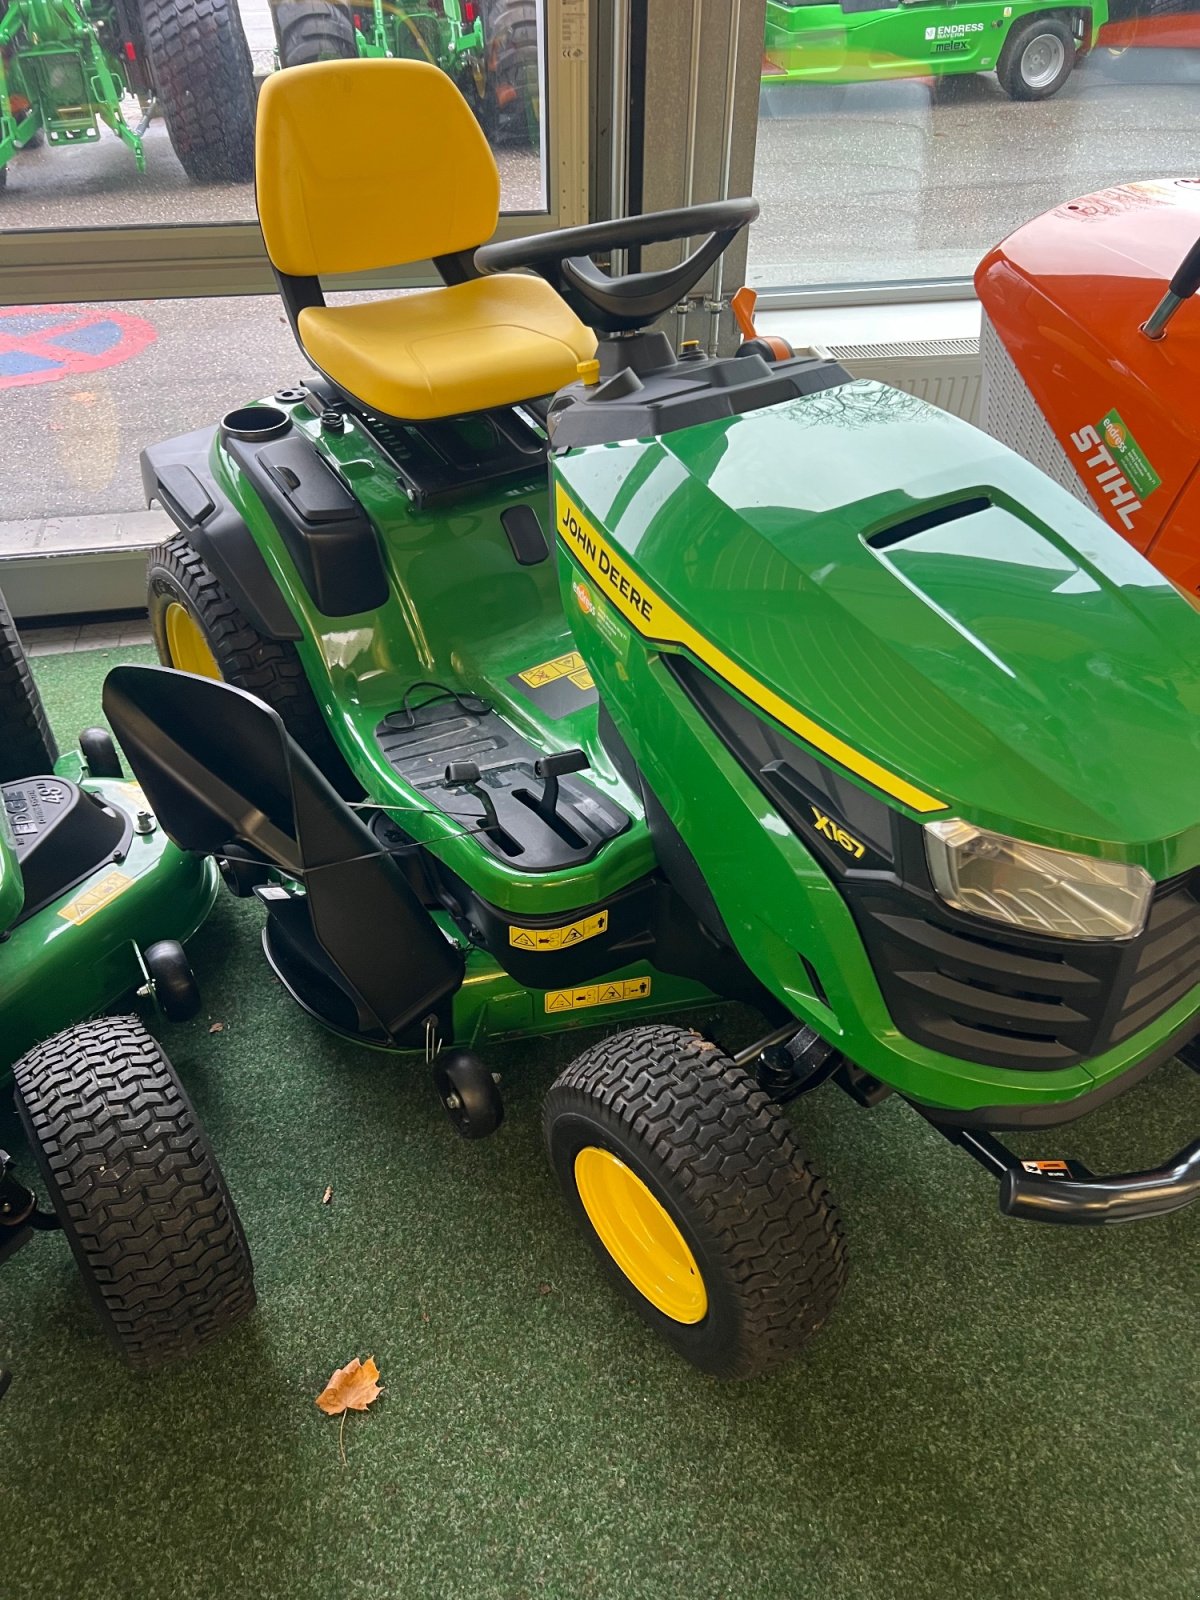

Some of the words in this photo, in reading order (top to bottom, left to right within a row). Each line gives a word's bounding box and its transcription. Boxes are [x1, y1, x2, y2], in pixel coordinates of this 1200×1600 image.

[936, 40, 967, 51] melex
[937, 22, 984, 34] ENDRESS
[1103, 418, 1127, 453] endress
[1069, 424, 1142, 530] STIHL
[562, 507, 596, 562] JOHN
[598, 548, 653, 623] DEERE
[3, 790, 38, 836] EDGE
[810, 805, 865, 858] X167
